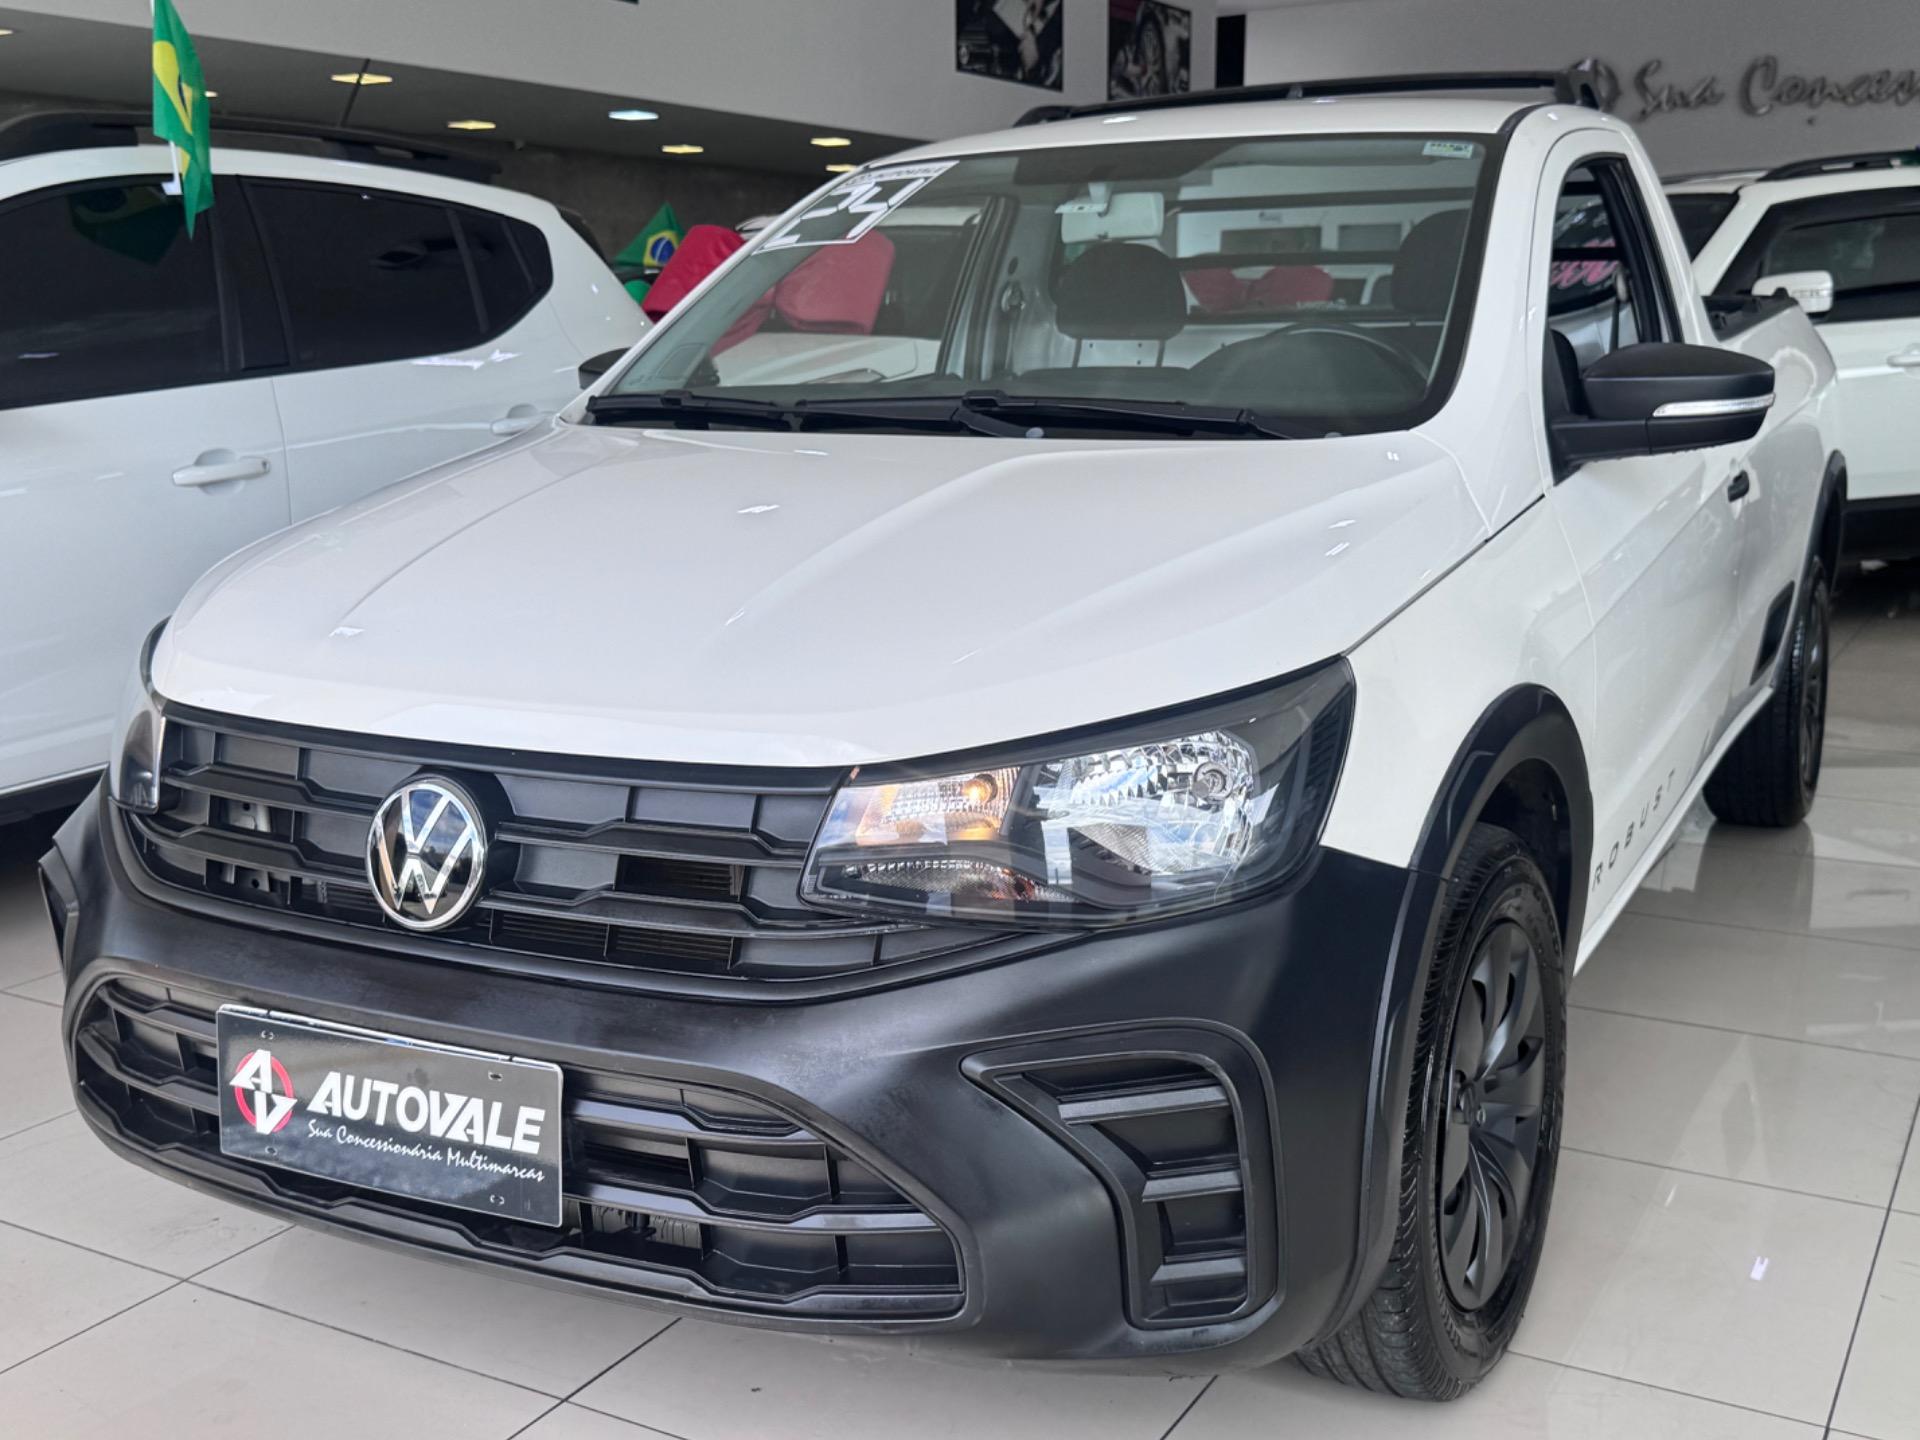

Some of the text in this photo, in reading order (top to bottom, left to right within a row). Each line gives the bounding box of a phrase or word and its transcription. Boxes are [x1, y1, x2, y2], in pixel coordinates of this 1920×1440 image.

[1633, 58, 1724, 122] Sua
[1592, 768, 1675, 892] ROBUST
[306, 1071, 546, 1155] AUTOVALE
[308, 1118, 545, 1182] Sua Concessionária Multimarcas
